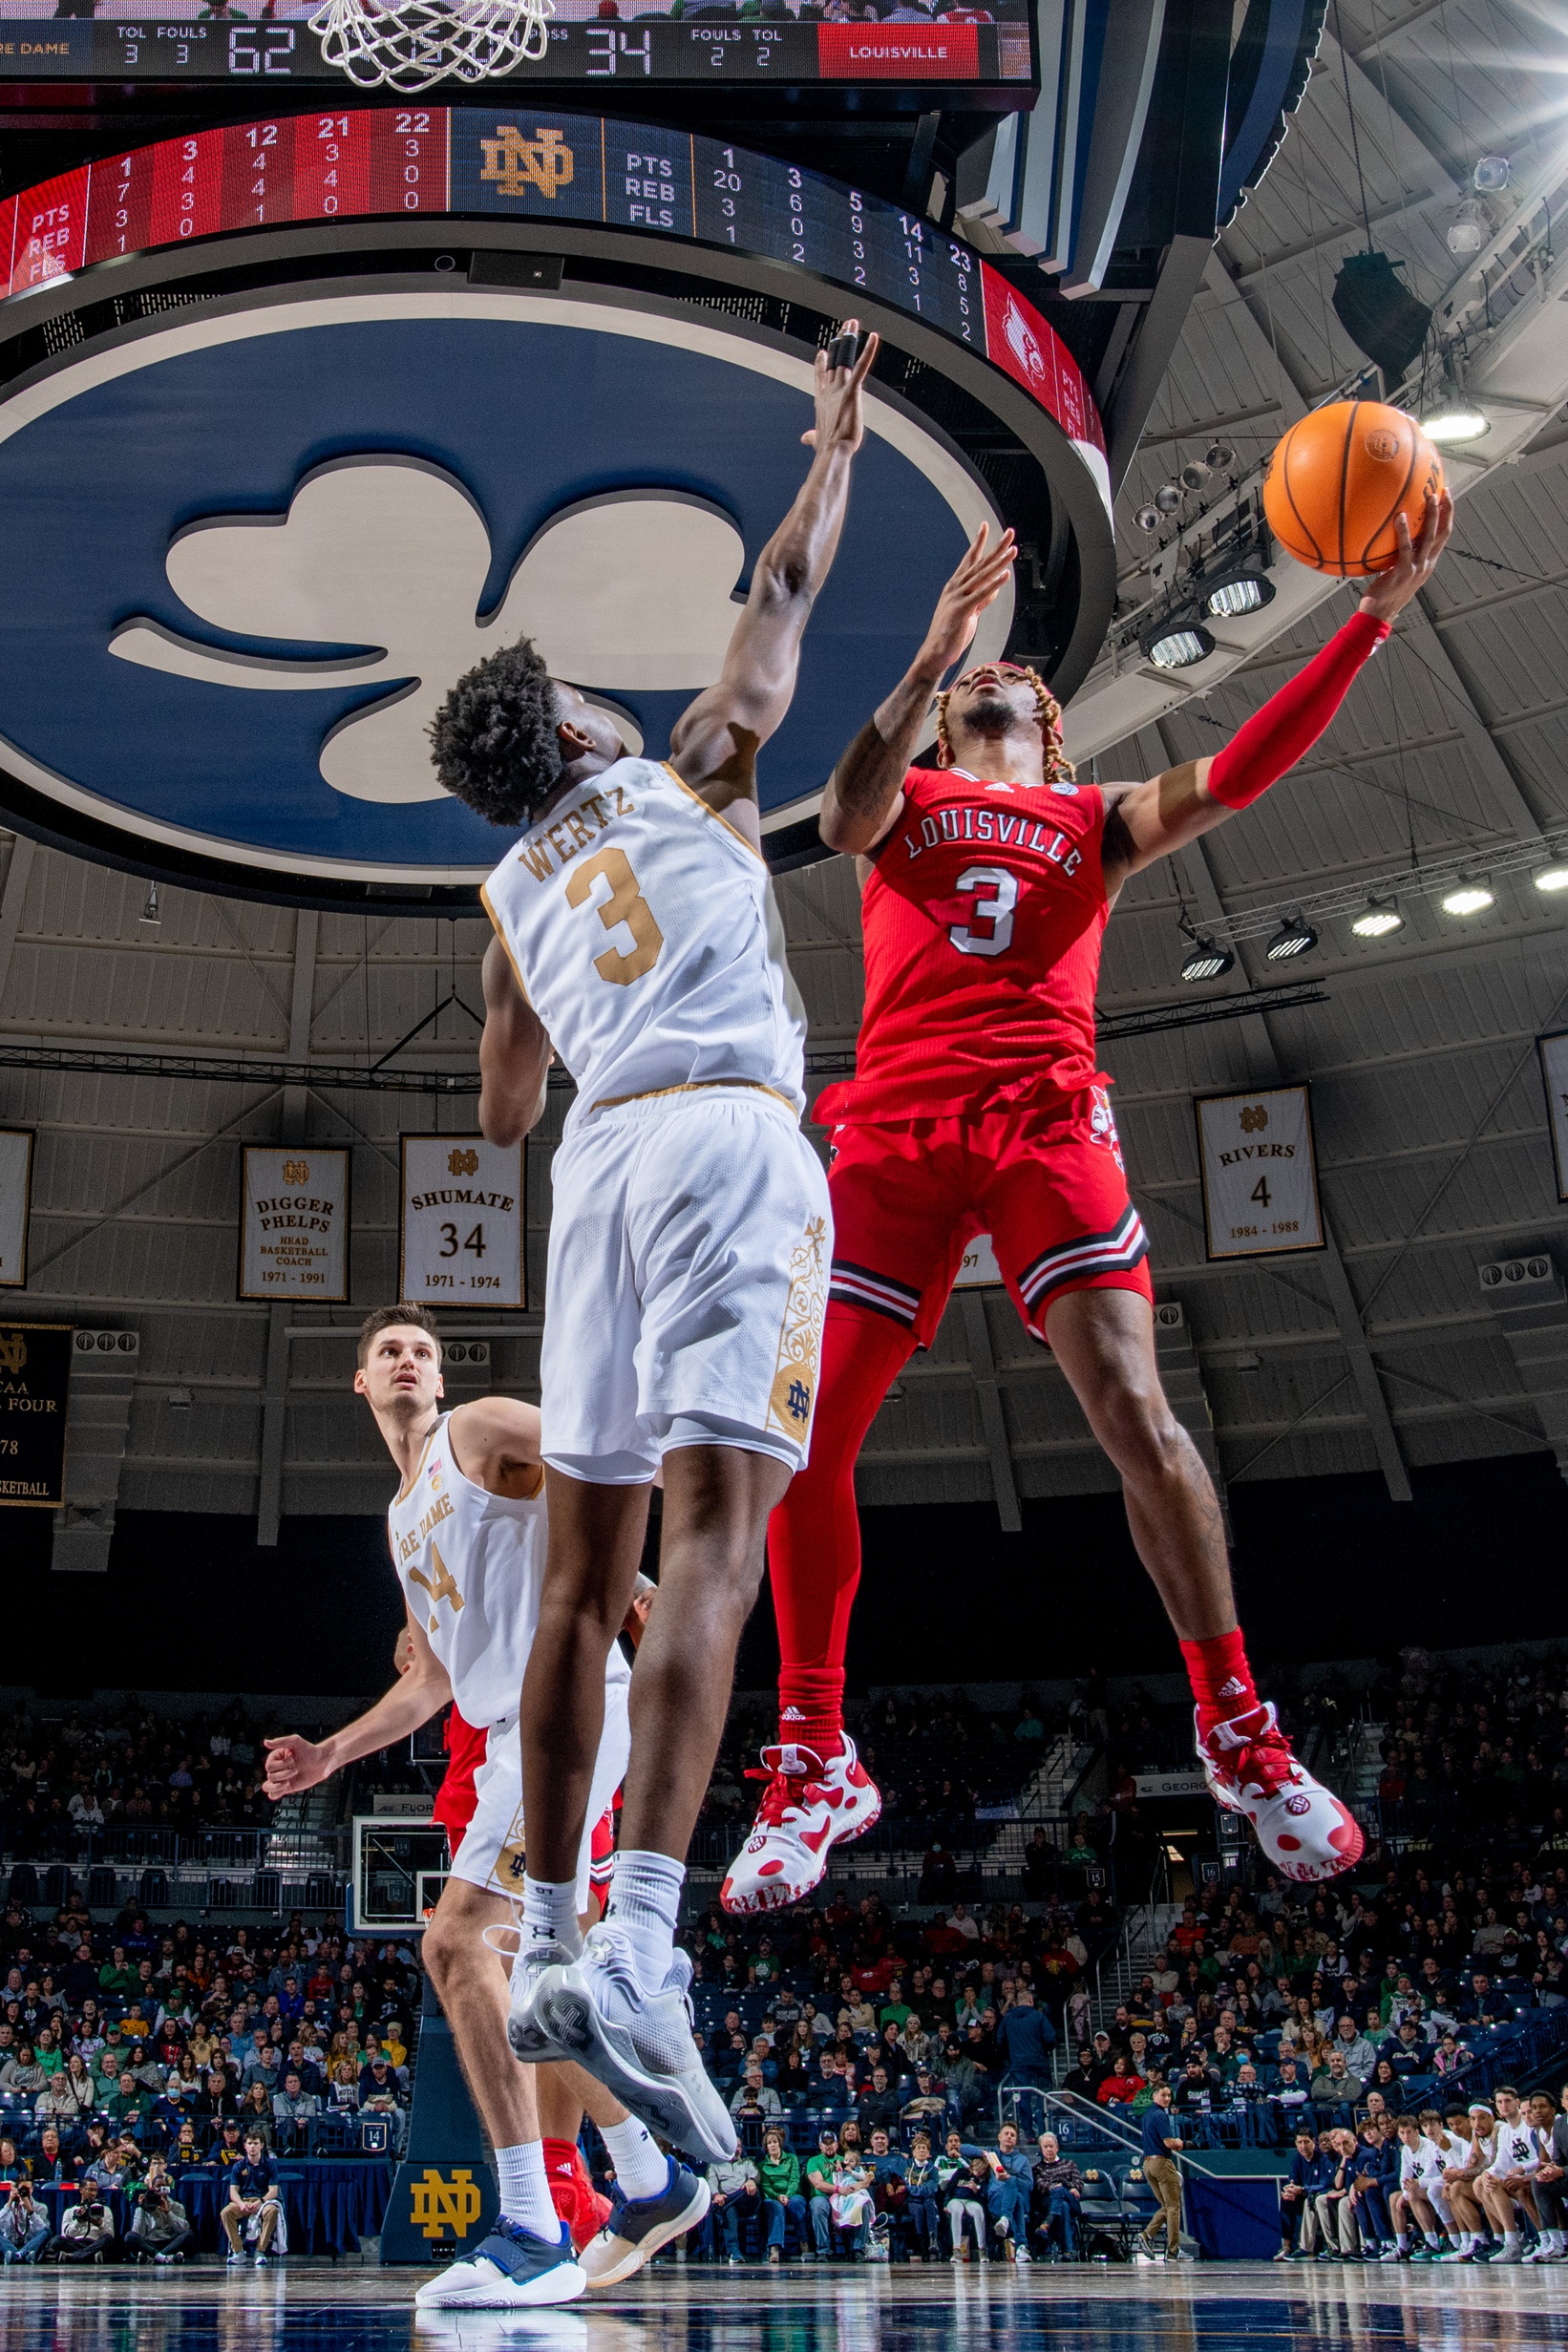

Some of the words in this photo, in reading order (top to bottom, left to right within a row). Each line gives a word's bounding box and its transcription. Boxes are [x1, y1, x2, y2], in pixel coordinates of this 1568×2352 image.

[117, 27, 146, 38] TOL
[158, 27, 206, 39] FOULS
[690, 30, 742, 41] FOULS
[752, 30, 782, 41] TOL
[20, 43, 70, 54] DAME
[125, 44, 138, 63] 3
[177, 44, 188, 63] 3
[229, 27, 295, 74] 62
[586, 29, 651, 75] 34
[710, 47, 723, 67] 2
[756, 47, 770, 67] 2
[849, 46, 947, 59] LOUISVILLE
[121, 157, 132, 177] 1
[183, 140, 198, 160] 3
[245, 125, 277, 147] 12
[317, 116, 349, 138] 21
[394, 113, 430, 133] 22
[32, 203, 70, 233] PTS
[117, 182, 130, 201] 7
[181, 166, 195, 183] 4
[252, 152, 265, 170] 4
[326, 143, 339, 161] 3
[406, 139, 419, 157] 3
[29, 227, 70, 258] REB
[116, 209, 128, 227] 3
[181, 192, 194, 210] 3
[251, 178, 265, 196] 4
[324, 169, 338, 187] 4
[405, 165, 419, 183] 0
[723, 148, 734, 169] 1
[788, 167, 802, 188] 3
[849, 191, 863, 212] 5
[899, 215, 923, 243] 14
[949, 244, 972, 273] 23
[117, 234, 126, 252] 1
[180, 218, 193, 236] 0
[255, 203, 264, 222] 1
[324, 196, 338, 214] 0
[404, 191, 419, 209] 0
[626, 153, 672, 178] PTS
[713, 169, 742, 192] 20
[789, 194, 802, 212] 6
[851, 215, 862, 234] 9
[904, 241, 922, 264] 11
[958, 273, 967, 292] 8
[625, 177, 675, 202] REB
[721, 197, 735, 217] 3
[791, 217, 803, 236] 0
[853, 240, 864, 259] 3
[908, 266, 920, 286] 3
[960, 296, 969, 315] 5
[630, 203, 674, 227] FLS
[726, 224, 735, 244] 1
[793, 243, 805, 263] 2
[854, 265, 866, 286] 2
[913, 293, 921, 311] 1
[962, 321, 971, 341] 2
[518, 786, 635, 882] WERTZ
[903, 808, 1083, 878] LOUISVILLE
[565, 846, 664, 986] 3
[949, 866, 1019, 956] 3
[1218, 1143, 1296, 1168] RIVERS
[412, 1190, 515, 1212] SHUMATE
[1250, 1176, 1272, 1208] 4
[255, 1197, 334, 1217] DIGGER
[260, 1215, 330, 1233] PHELPS
[1231, 1226, 1258, 1239] 1984
[1272, 1220, 1300, 1235] 1988
[280, 1236, 309, 1245] HEAD
[438, 1222, 487, 1259] 34
[260, 1245, 328, 1257] BASKETBALL
[276, 1257, 312, 1266] COACH
[262, 1271, 286, 1282] 1971
[300, 1273, 326, 1283] 1991
[425, 1274, 455, 1288] 1971
[470, 1276, 500, 1289] 1974
[8, 1397, 58, 1412] FOUR
[419, 1493, 455, 1540] DAME
[1091, 1873, 1101, 1882] 15
[1206, 1868, 1216, 1877] 16
[369, 2130, 380, 2141] 14
[905, 2126, 917, 2138] 15
[1057, 2123, 1070, 2135] 16
